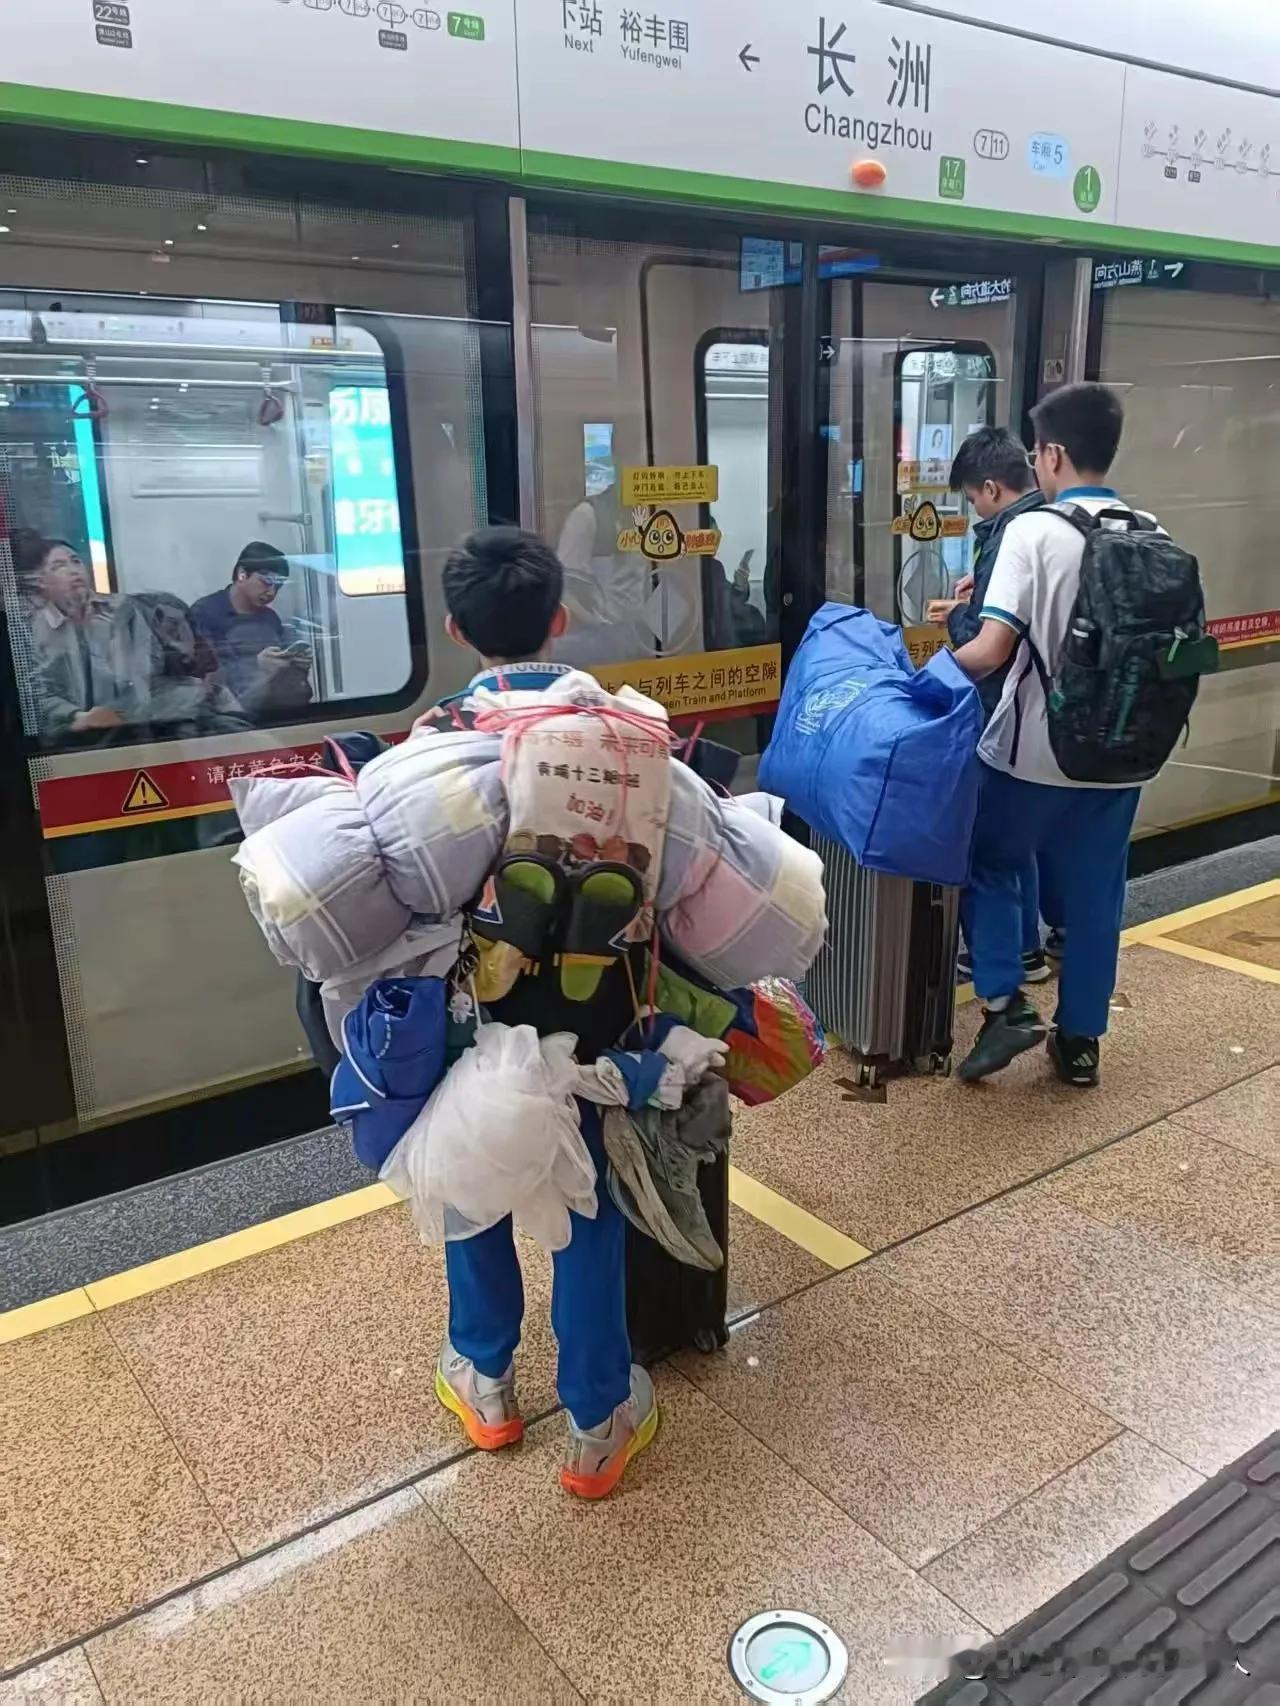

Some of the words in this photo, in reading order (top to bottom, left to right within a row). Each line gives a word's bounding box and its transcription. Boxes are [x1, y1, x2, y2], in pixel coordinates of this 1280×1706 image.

[620, 9, 689, 53] 裕丰围
[564, 34, 593, 53] Next
[620, 44, 682, 69] Yufengwei
[807, 17, 931, 113] 长洲
[804, 103, 932, 151] Changzhou
[945, 160, 961, 177] 17
[601, 661, 777, 697] 与列车之间的空隙
[683, 696, 706, 706] Train
[709, 692, 726, 703] and
[728, 687, 767, 699] Platform
